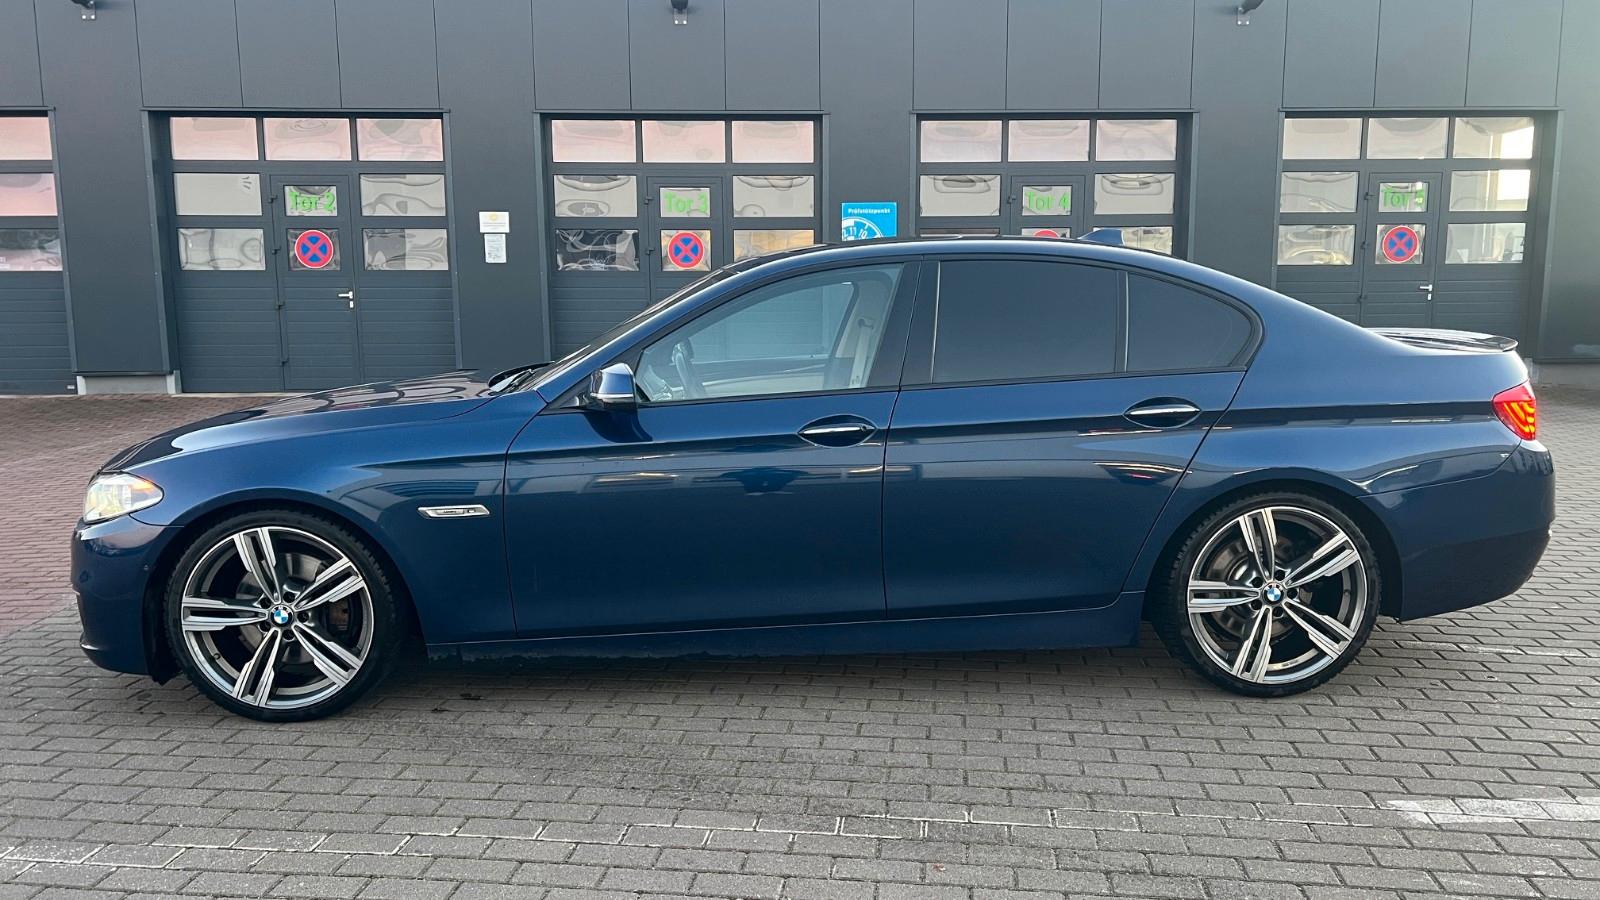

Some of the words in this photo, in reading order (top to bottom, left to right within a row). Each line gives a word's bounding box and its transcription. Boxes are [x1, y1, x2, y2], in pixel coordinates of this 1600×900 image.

[289, 191, 317, 211] Tor
[324, 191, 336, 212] 2
[664, 192, 694, 213] Tor
[698, 192, 708, 213] 3
[1025, 191, 1054, 211] Tor
[1060, 192, 1070, 211] 4
[1381, 188, 1411, 209] Tor
